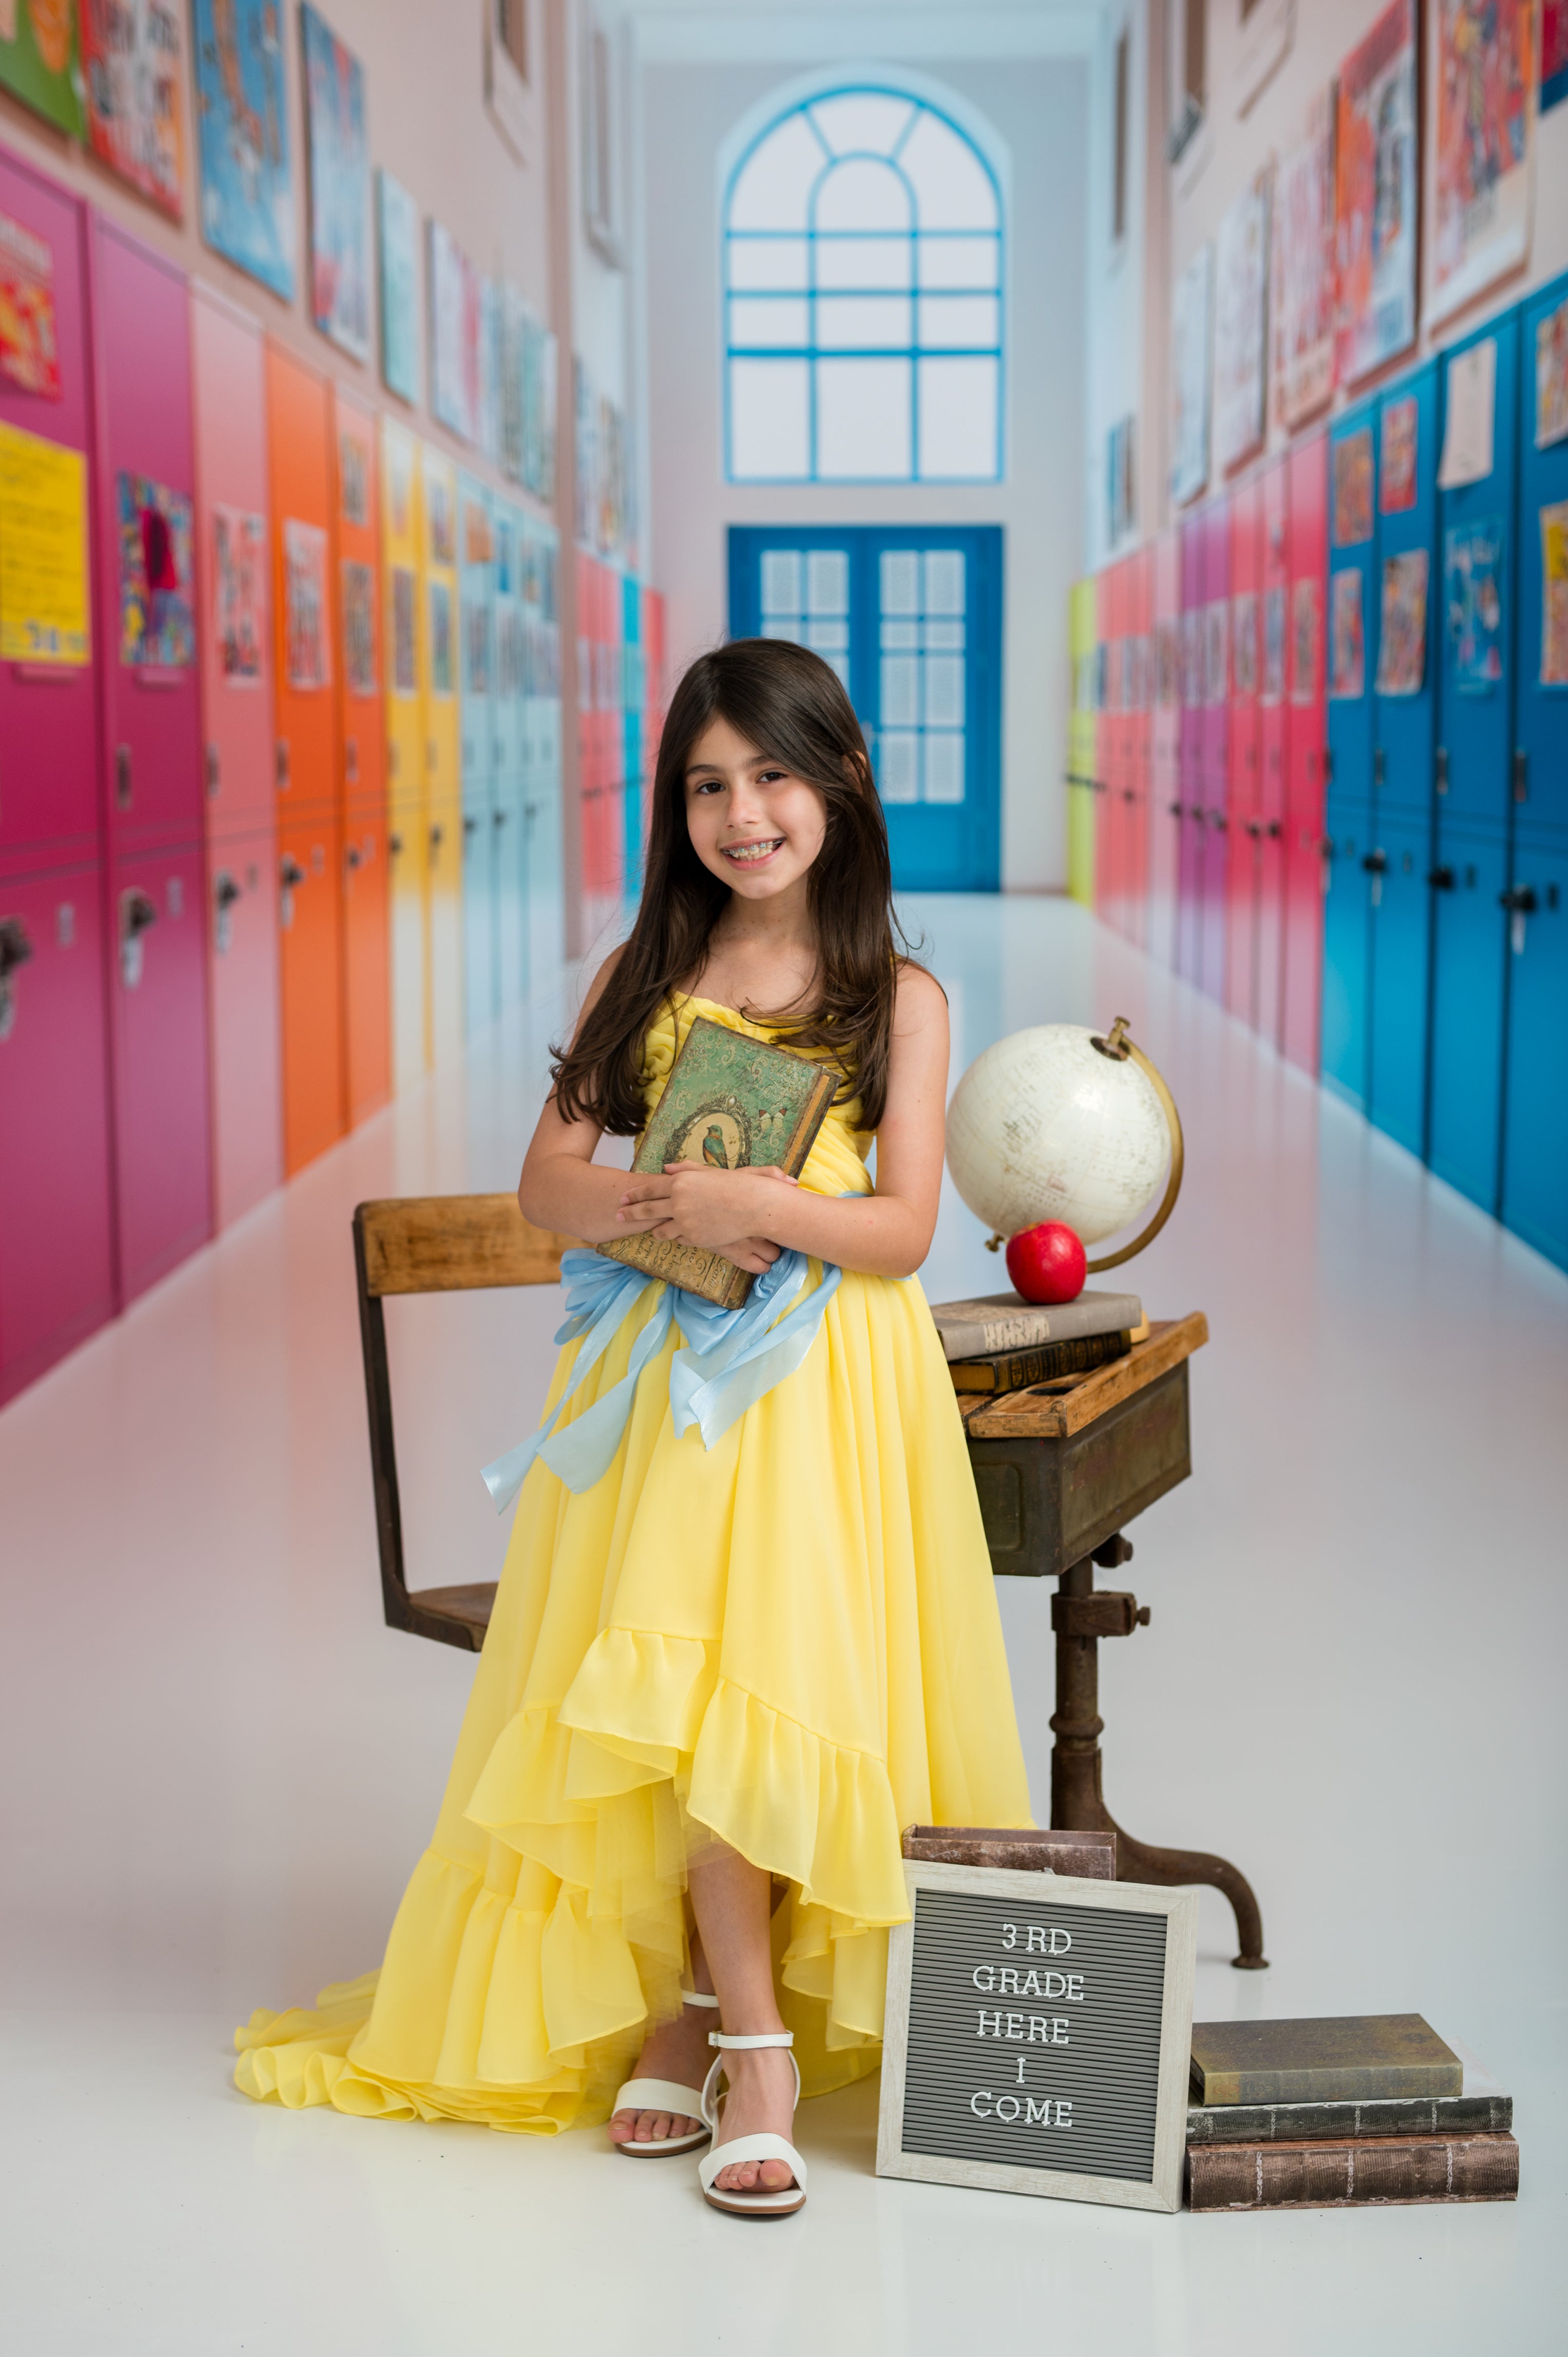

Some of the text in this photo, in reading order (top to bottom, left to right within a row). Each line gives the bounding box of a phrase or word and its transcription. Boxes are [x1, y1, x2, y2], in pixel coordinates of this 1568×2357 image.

[973, 1965, 1084, 2001] GRADE
[976, 2010, 1069, 2044] HERE
[1016, 2057, 1026, 2083] I
[970, 2091, 1072, 2127] COME
